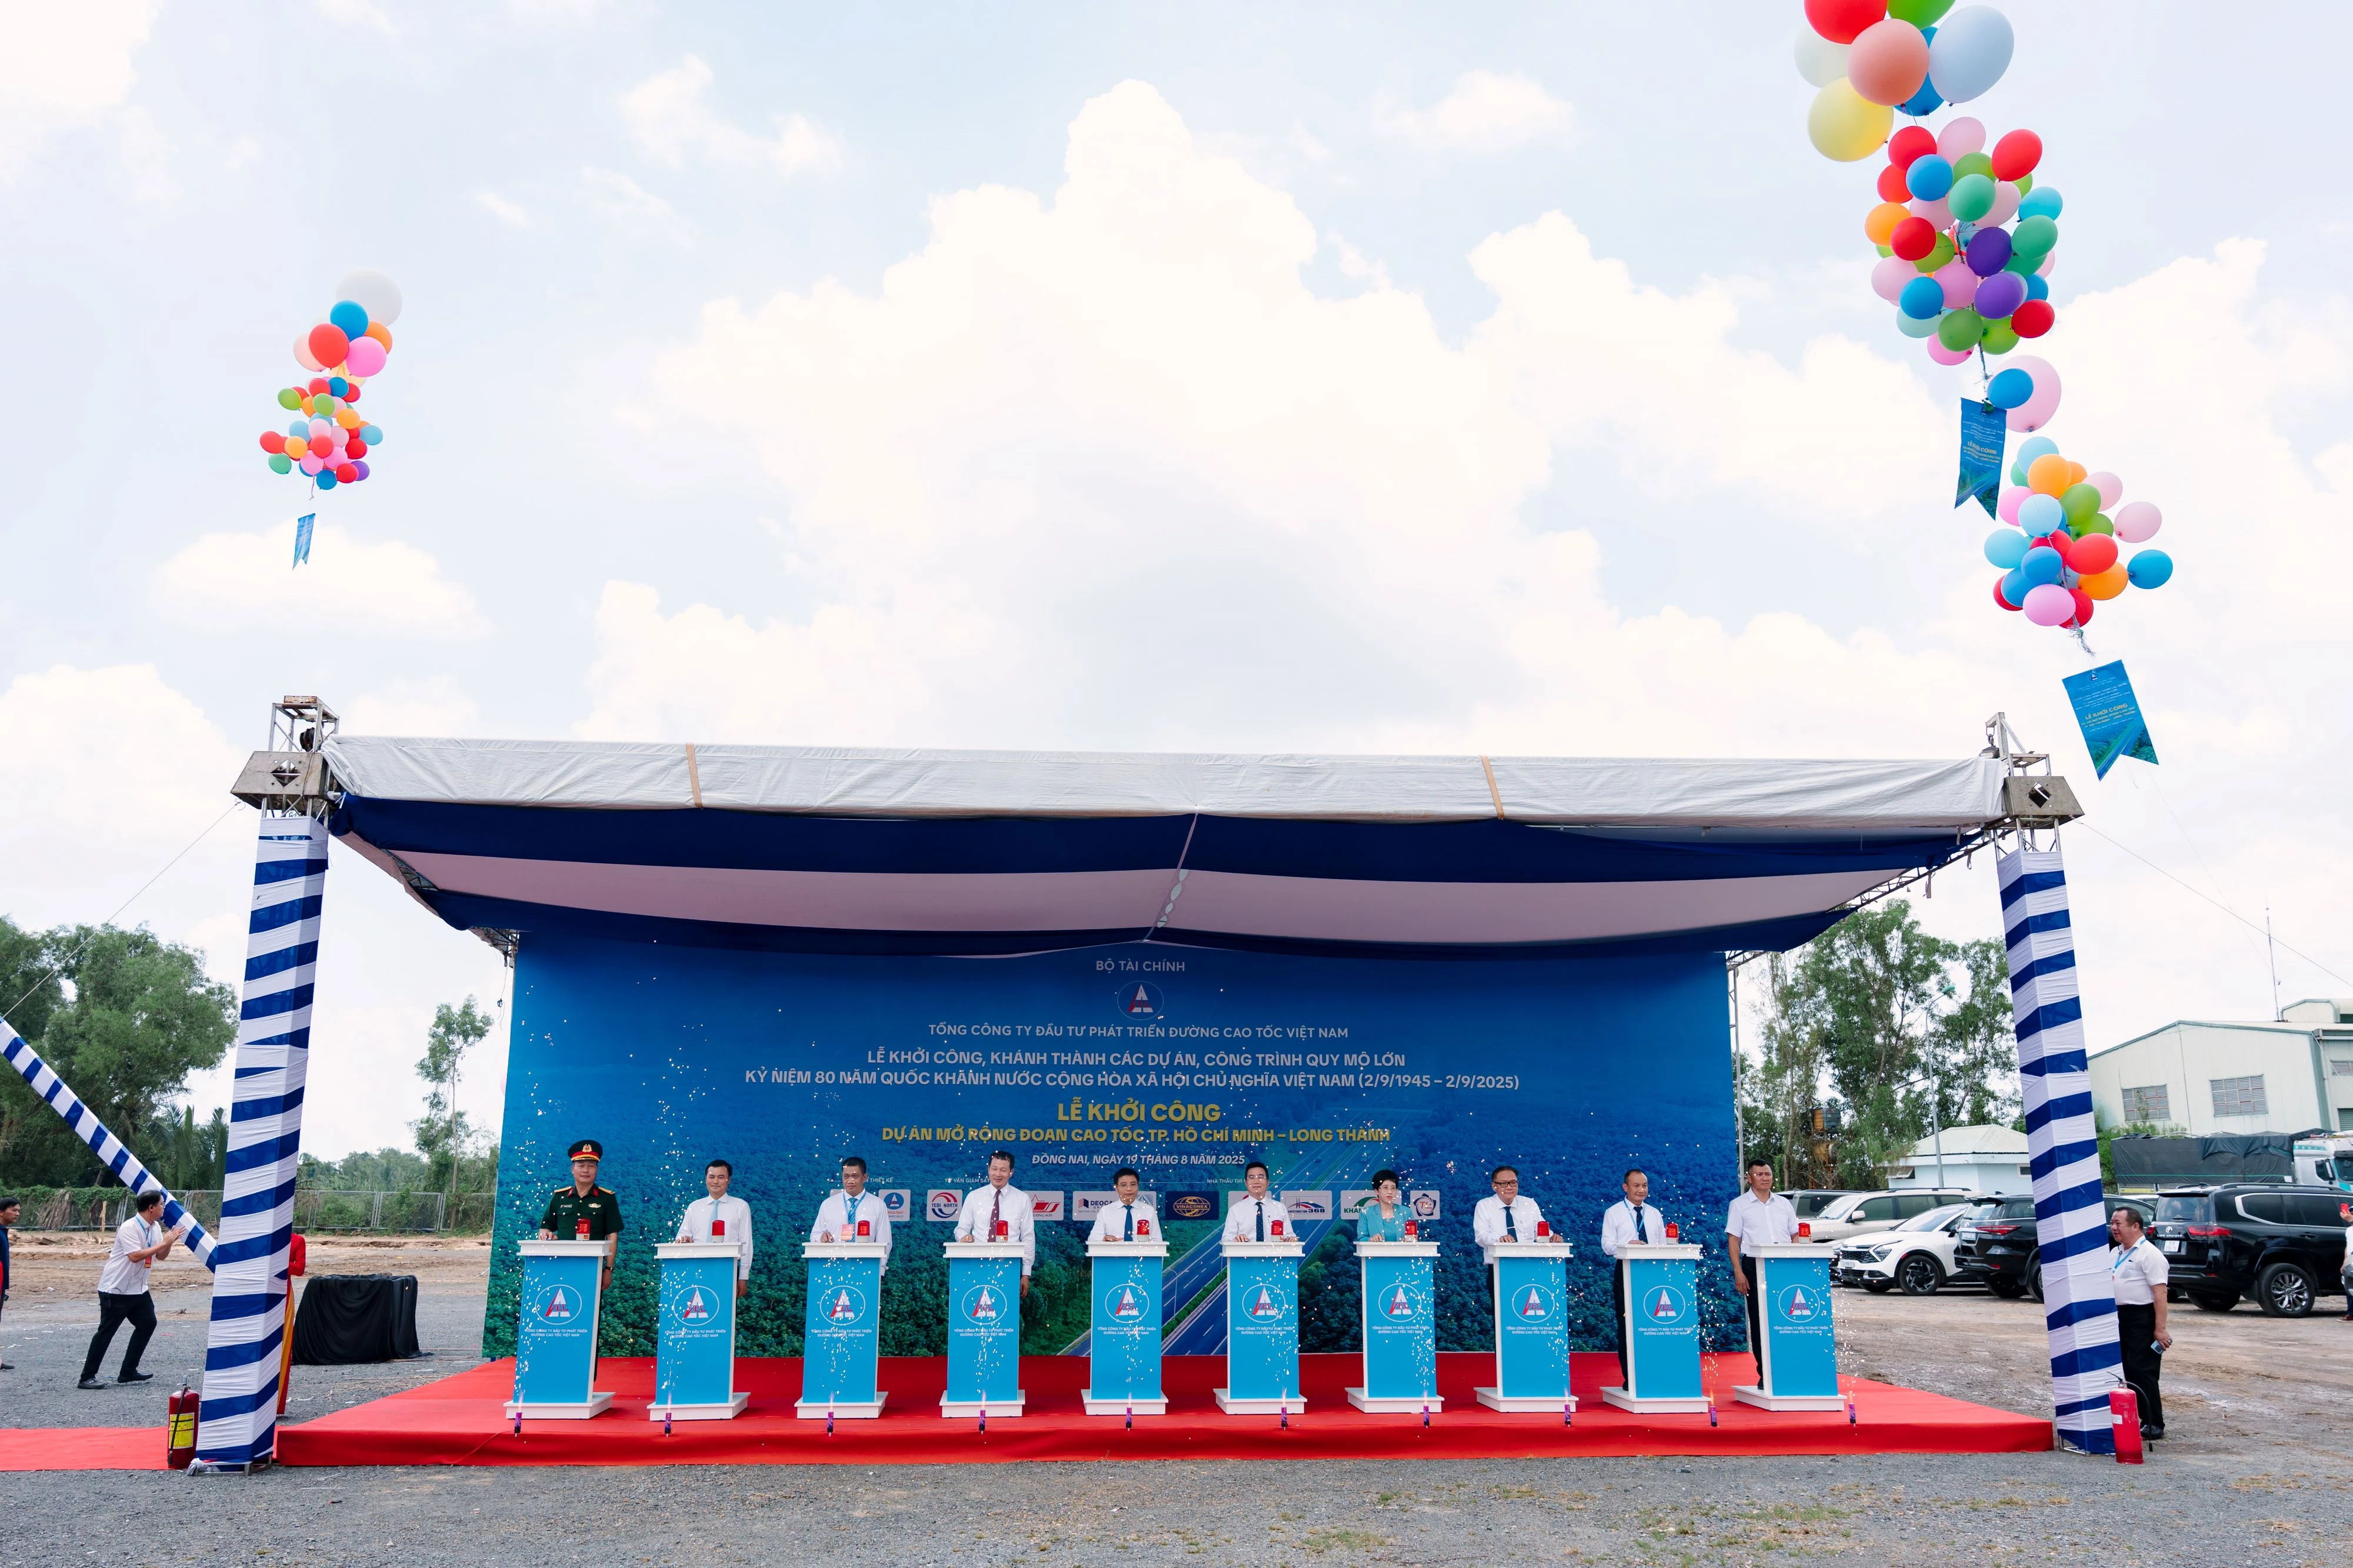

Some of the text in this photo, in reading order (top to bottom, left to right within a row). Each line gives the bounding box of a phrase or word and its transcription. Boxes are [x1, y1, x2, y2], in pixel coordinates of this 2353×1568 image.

[1096, 958, 1185, 973] BỘ TÀI CHÍNH
[929, 1021, 1348, 1040] TỔNG CÔNG TY ĐẦU TƯ PHÁT TRIỂN ĐƯỜNG CAO TỐC VIỆT NAM
[868, 1046, 1405, 1068] LỄ KHỞI CÔNG, KHÁNH THÀNH CÁC DỰ ÁN, CÔNG TRÌNH QUY MÔ LỚN
[746, 1067, 768, 1083] KỶ
[772, 1068, 811, 1086] NIỆM
[815, 1070, 836, 1084] 80
[840, 1069, 876, 1085] NĂM
[880, 1068, 929, 1085] QUỐC
[934, 1069, 991, 1085] KHÁNH
[995, 1070, 1042, 1085] NƯỚC
[1046, 1071, 1094, 1089] CỘNG
[1098, 1071, 1132, 1086] HÒA
[1136, 1072, 1158, 1086] XÃ
[1162, 1072, 1189, 1089] HỘI
[1194, 1070, 1227, 1086] CHỦ
[1231, 1072, 1279, 1087] NGHĨA
[1284, 1072, 1315, 1089] VIỆT
[1319, 1075, 1354, 1086] NAM
[1359, 1073, 1430, 1088] (2/9/1945
[1446, 1075, 1519, 1090] 2/9/2025)
[1058, 1097, 1220, 1122] LỄ KHỞI CÔNG
[882, 1126, 906, 1143] DỰ
[908, 1126, 932, 1140] ÁN
[936, 1124, 965, 1140] MỞ
[968, 1125, 1016, 1143] RỘNG
[1020, 1129, 1067, 1144] ĐOẠN
[1071, 1129, 1106, 1141] CAO
[1111, 1125, 1144, 1142] TỐC
[1148, 1129, 1169, 1142] TP.
[1174, 1126, 1197, 1142] HỒ
[1201, 1126, 1229, 1142] CHÍ
[1233, 1129, 1274, 1142] MINH
[1289, 1129, 1332, 1142] LONG
[1337, 1126, 1389, 1142] THÀNH
[1032, 1153, 1245, 1166] ĐỒNG NAI, NGÀY 19 THÁNG 8 NĂM 2025
